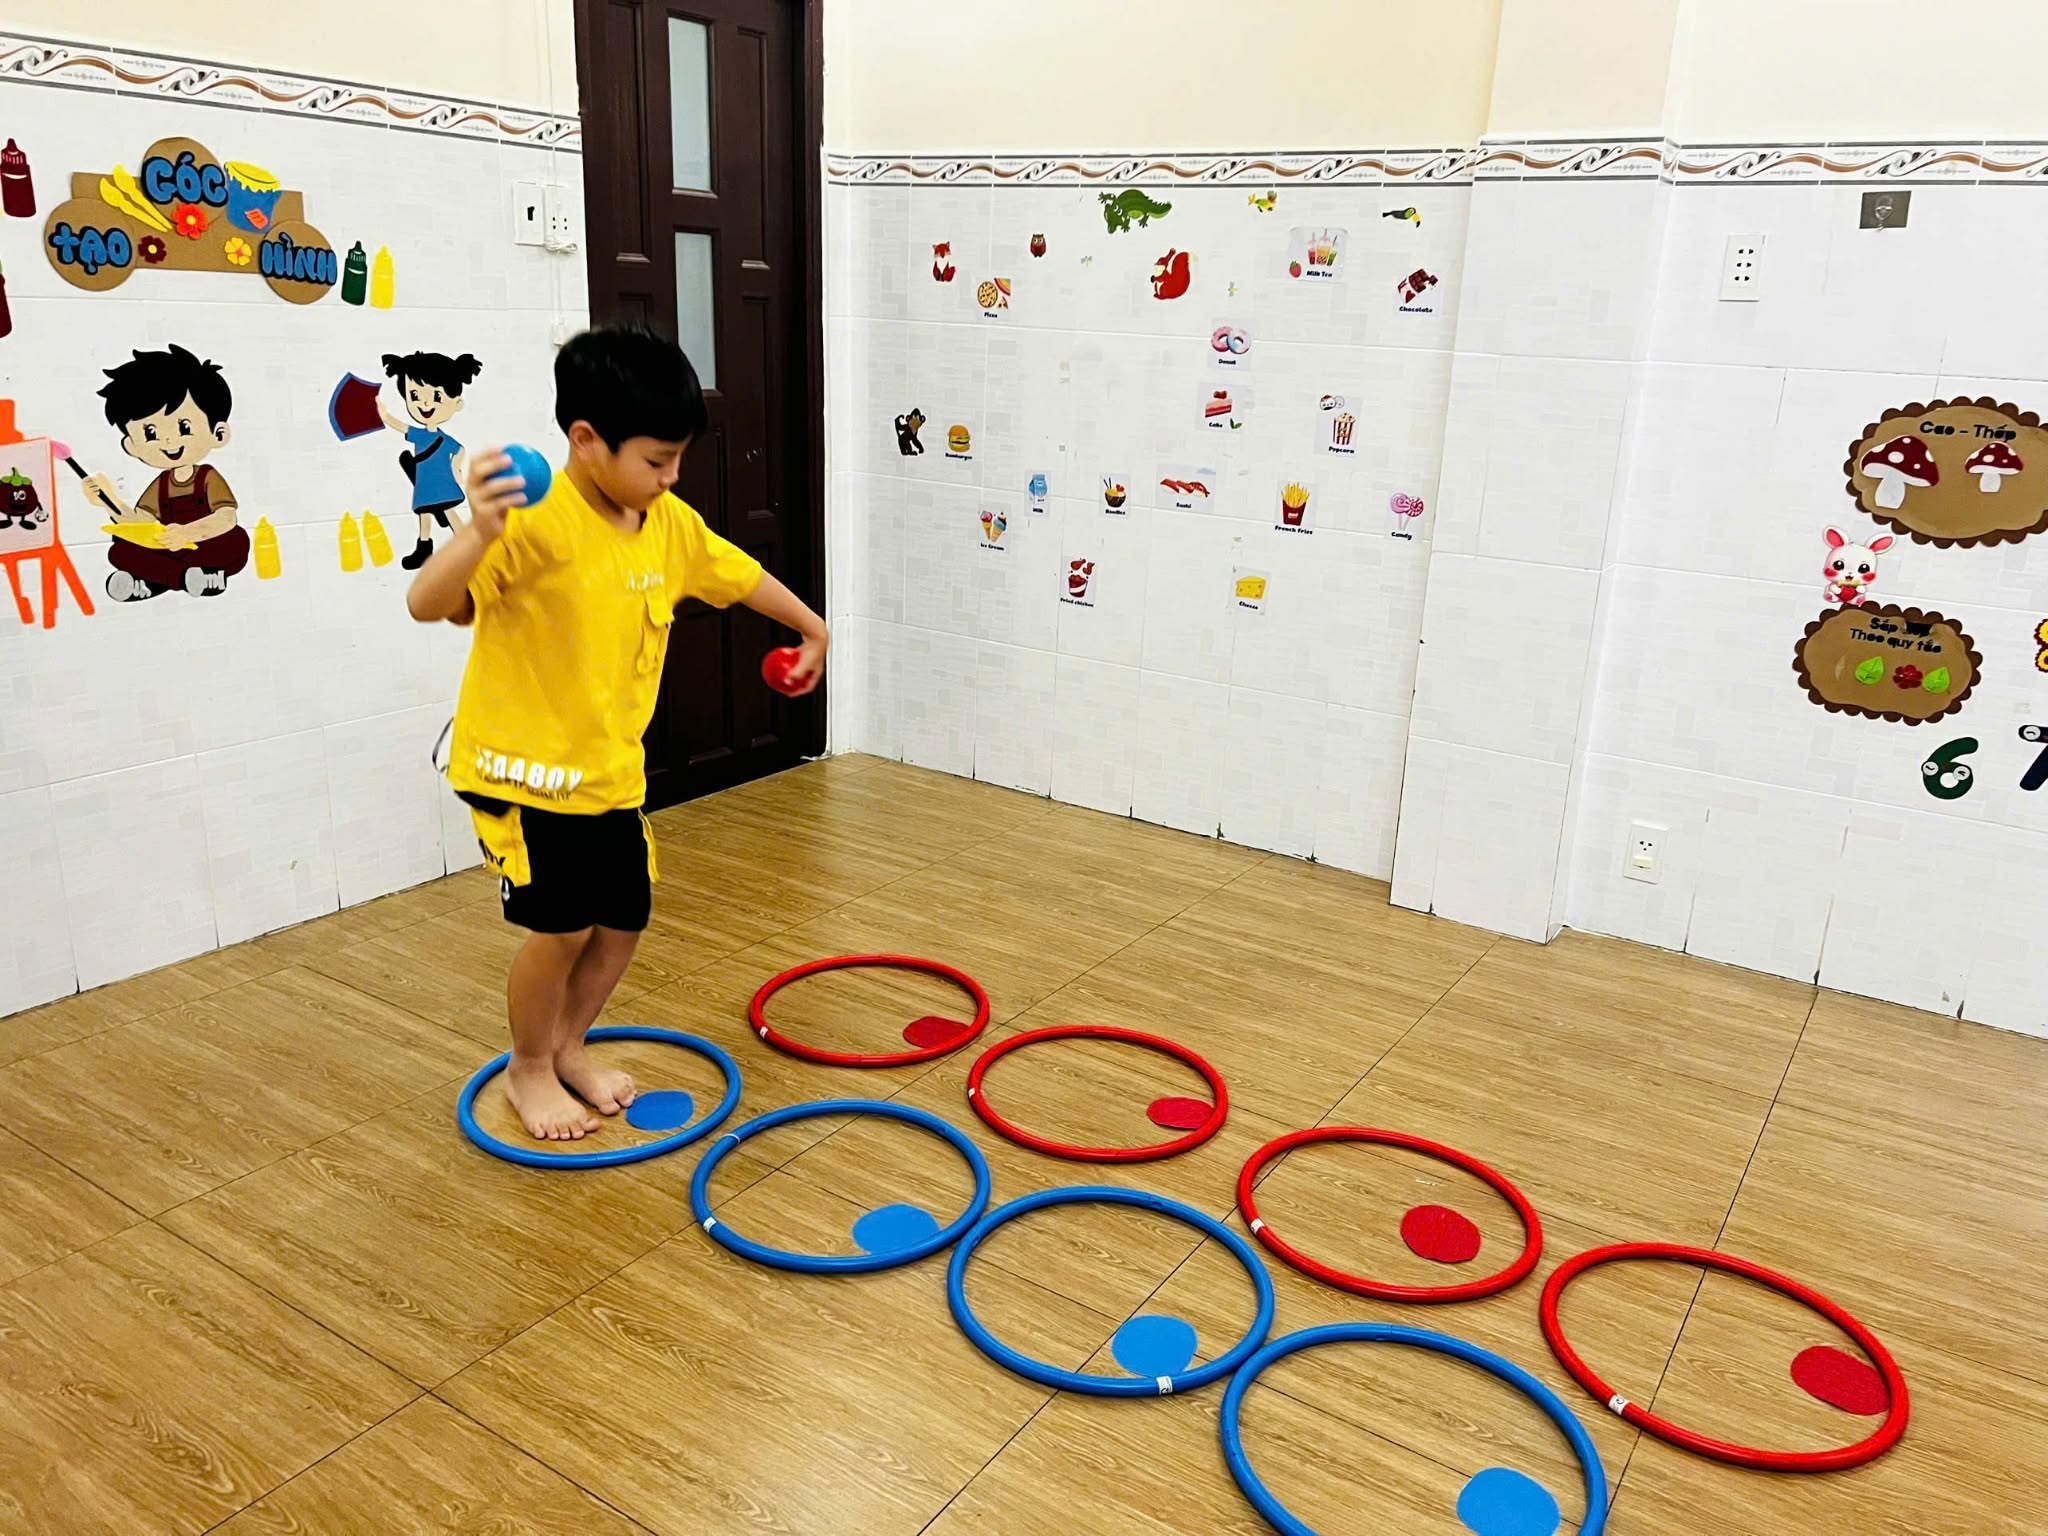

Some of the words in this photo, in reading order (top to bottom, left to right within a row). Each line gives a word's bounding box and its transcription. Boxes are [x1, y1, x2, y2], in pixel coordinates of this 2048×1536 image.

[141, 151, 229, 207] GÓC
[260, 232, 338, 286] HÌNH
[1920, 421, 1955, 435] Cao
[1850, 628, 1885, 643] Theo
[1887, 637, 1914, 650] quy
[1921, 736, 1979, 800] 6
[2018, 725, 2048, 791] 7
